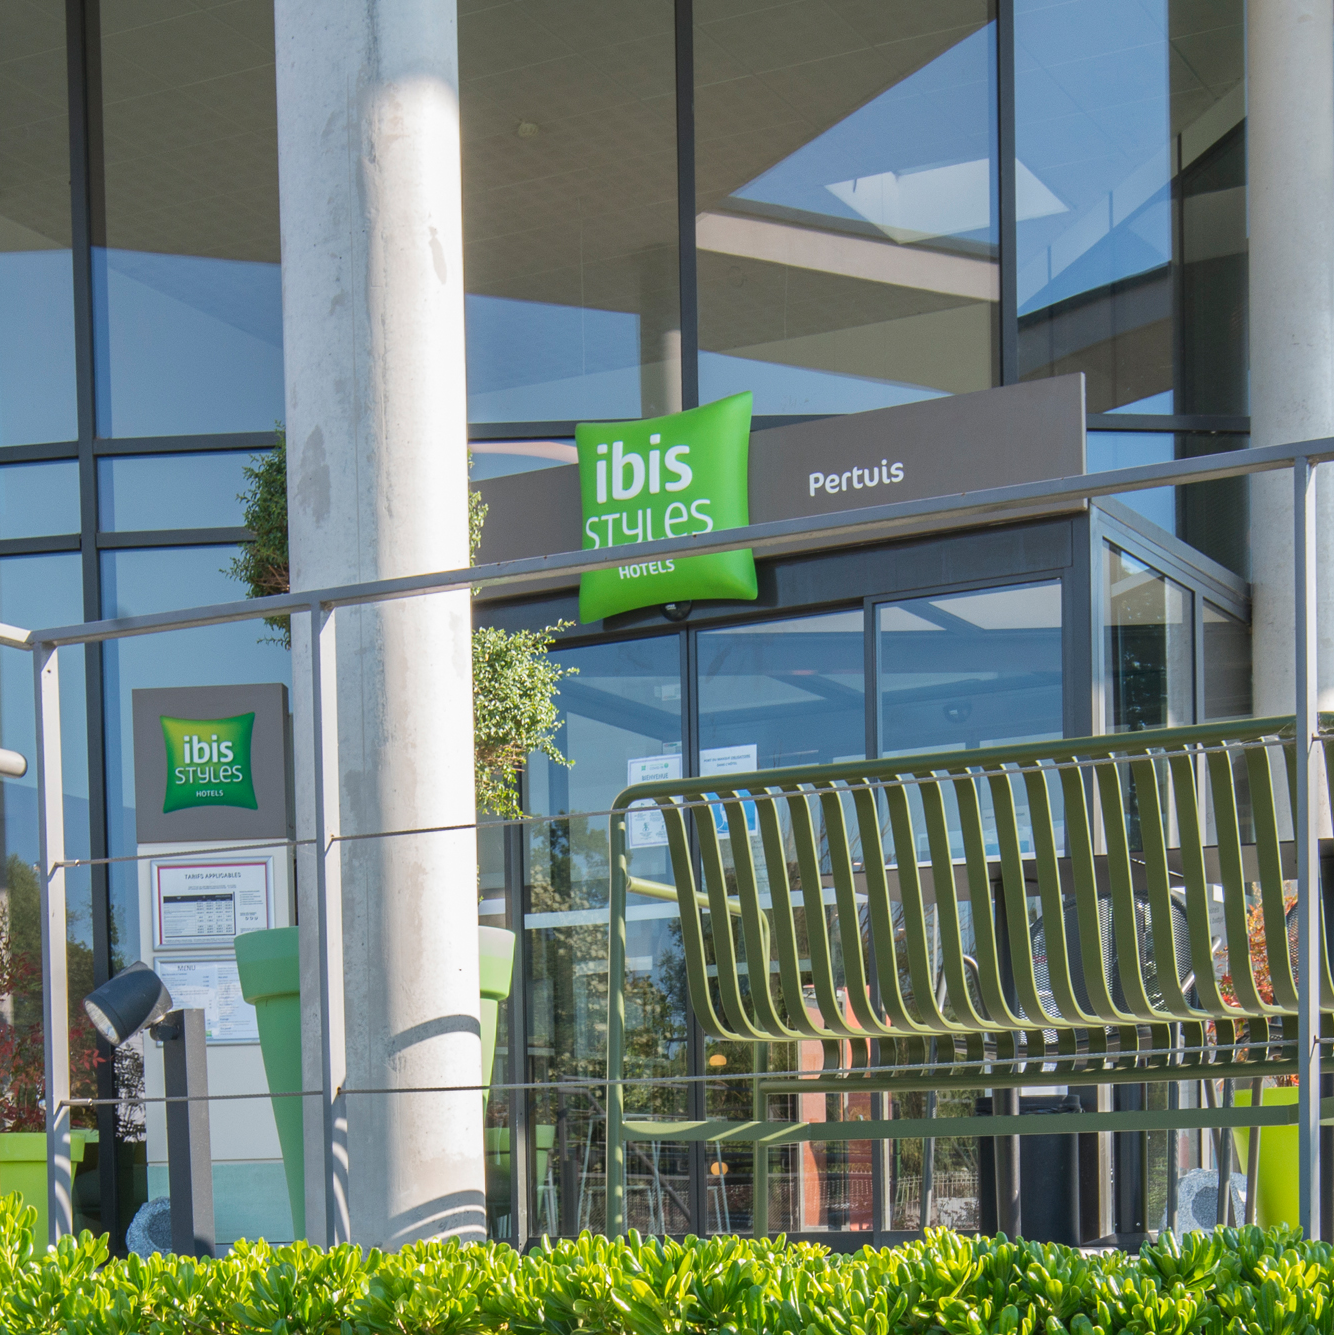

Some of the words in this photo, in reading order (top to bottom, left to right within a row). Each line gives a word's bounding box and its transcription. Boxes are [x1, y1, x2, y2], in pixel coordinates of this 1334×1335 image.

[596, 433, 693, 504] ibis
[809, 459, 904, 497] Pertuis
[619, 559, 675, 579] HOTELS
[183, 734, 234, 764] ibis
[196, 789, 224, 797] HOTELS
